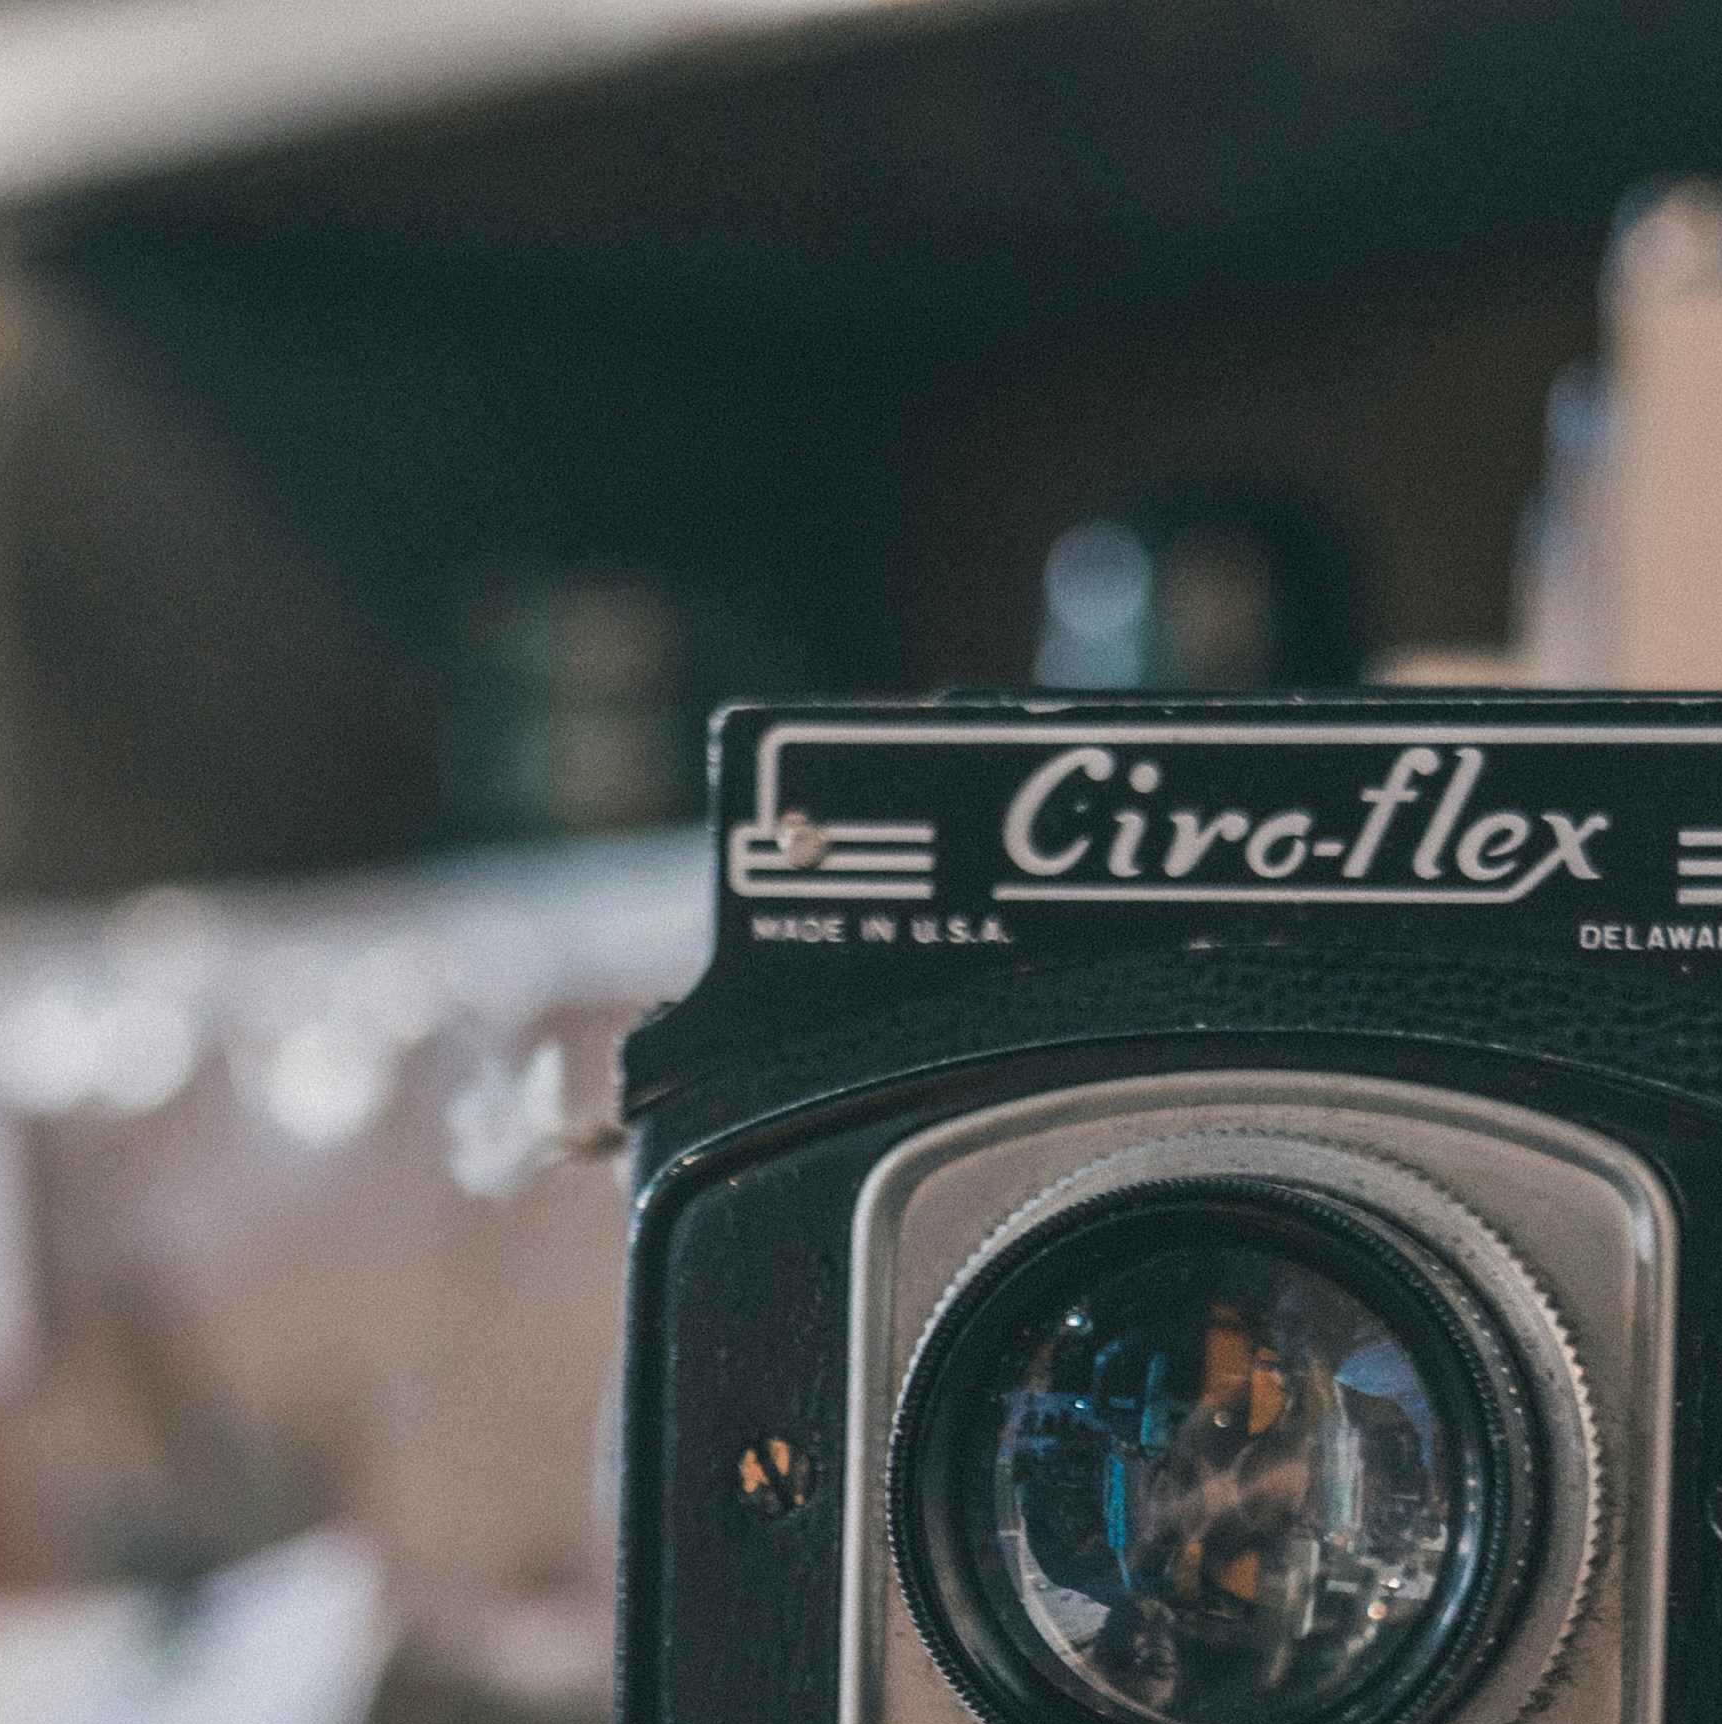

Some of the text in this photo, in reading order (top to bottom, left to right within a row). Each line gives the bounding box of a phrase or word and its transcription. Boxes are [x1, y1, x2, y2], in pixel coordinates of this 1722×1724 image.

[1003, 747, 1609, 881] Ciro-flex
[751, 916, 845, 943] MADE
[859, 916, 895, 943] IN
